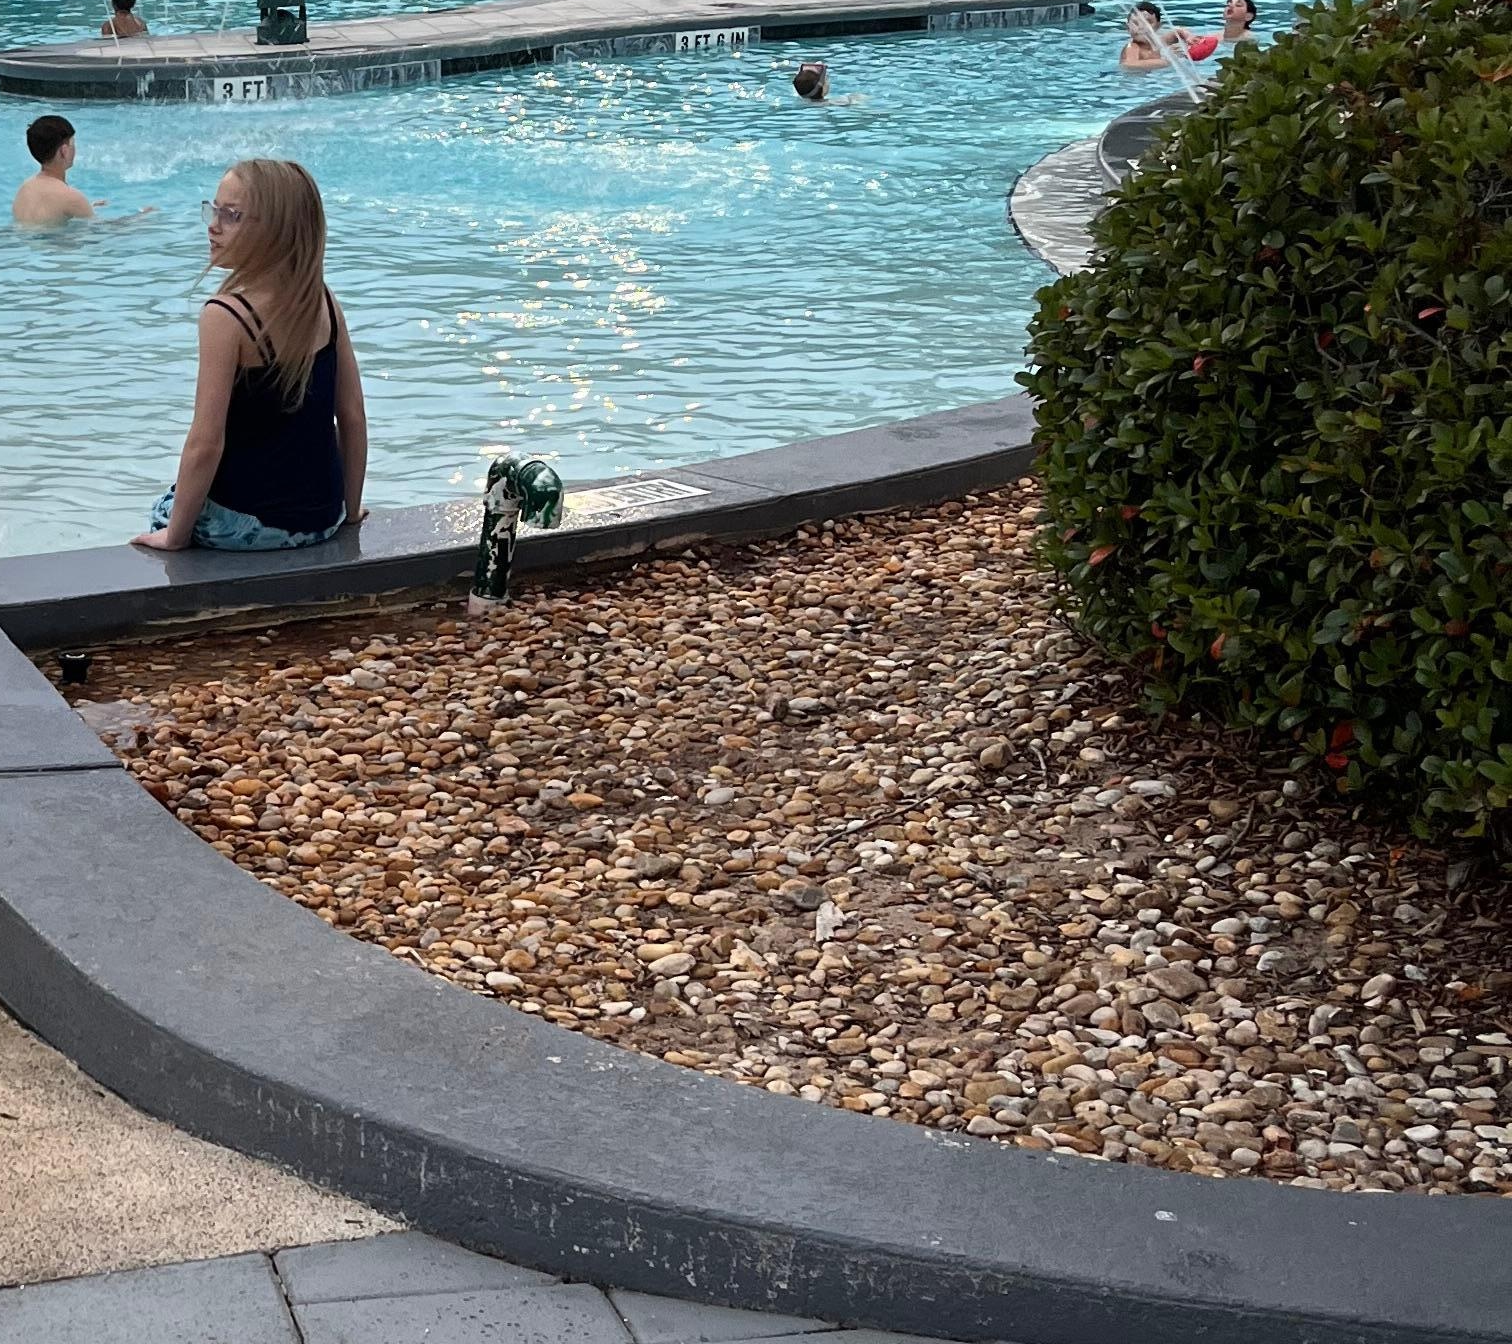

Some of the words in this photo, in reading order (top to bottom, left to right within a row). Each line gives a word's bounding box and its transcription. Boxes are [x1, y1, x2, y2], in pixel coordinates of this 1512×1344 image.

[681, 35, 689, 50] 3
[695, 34, 711, 49] FT
[731, 31, 745, 46] IN
[223, 82, 233, 99] 3
[242, 80, 264, 100] FT
